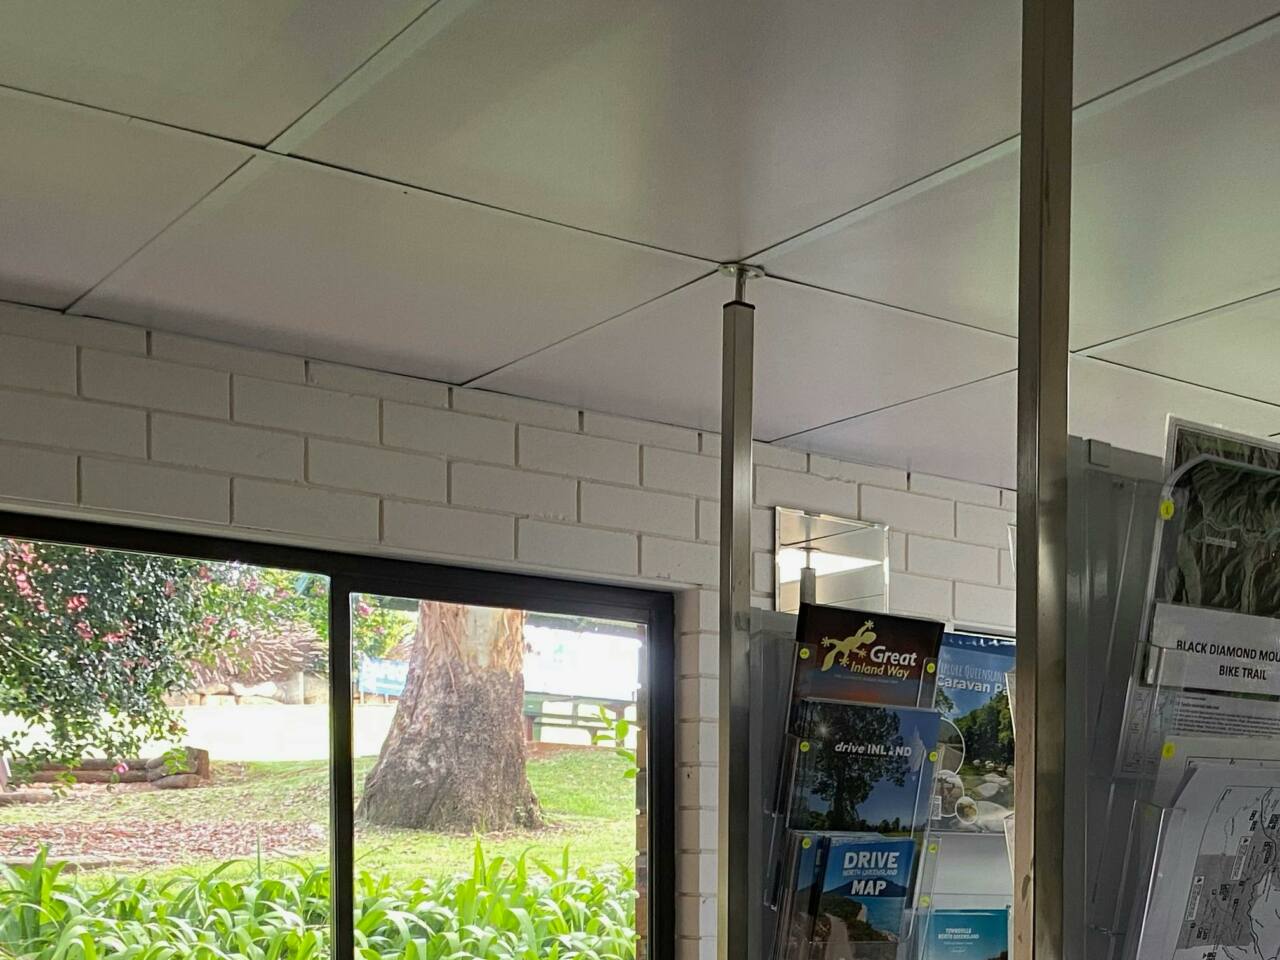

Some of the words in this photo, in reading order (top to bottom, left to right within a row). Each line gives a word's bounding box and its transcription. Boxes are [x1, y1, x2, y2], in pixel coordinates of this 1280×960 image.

[869, 645, 918, 667] Great
[1176, 639, 1208, 654] BLACK
[1208, 644, 1257, 660] DIAMOND
[850, 661, 884, 676] Inland
[884, 666, 911, 681] Way
[1219, 665, 1240, 678] BIKE
[1241, 668, 1268, 681] TRAIL
[937, 676, 991, 693] Caravan
[834, 741, 866, 754] drive
[843, 851, 900, 869] DRIVE
[850, 879, 887, 896] MAP
